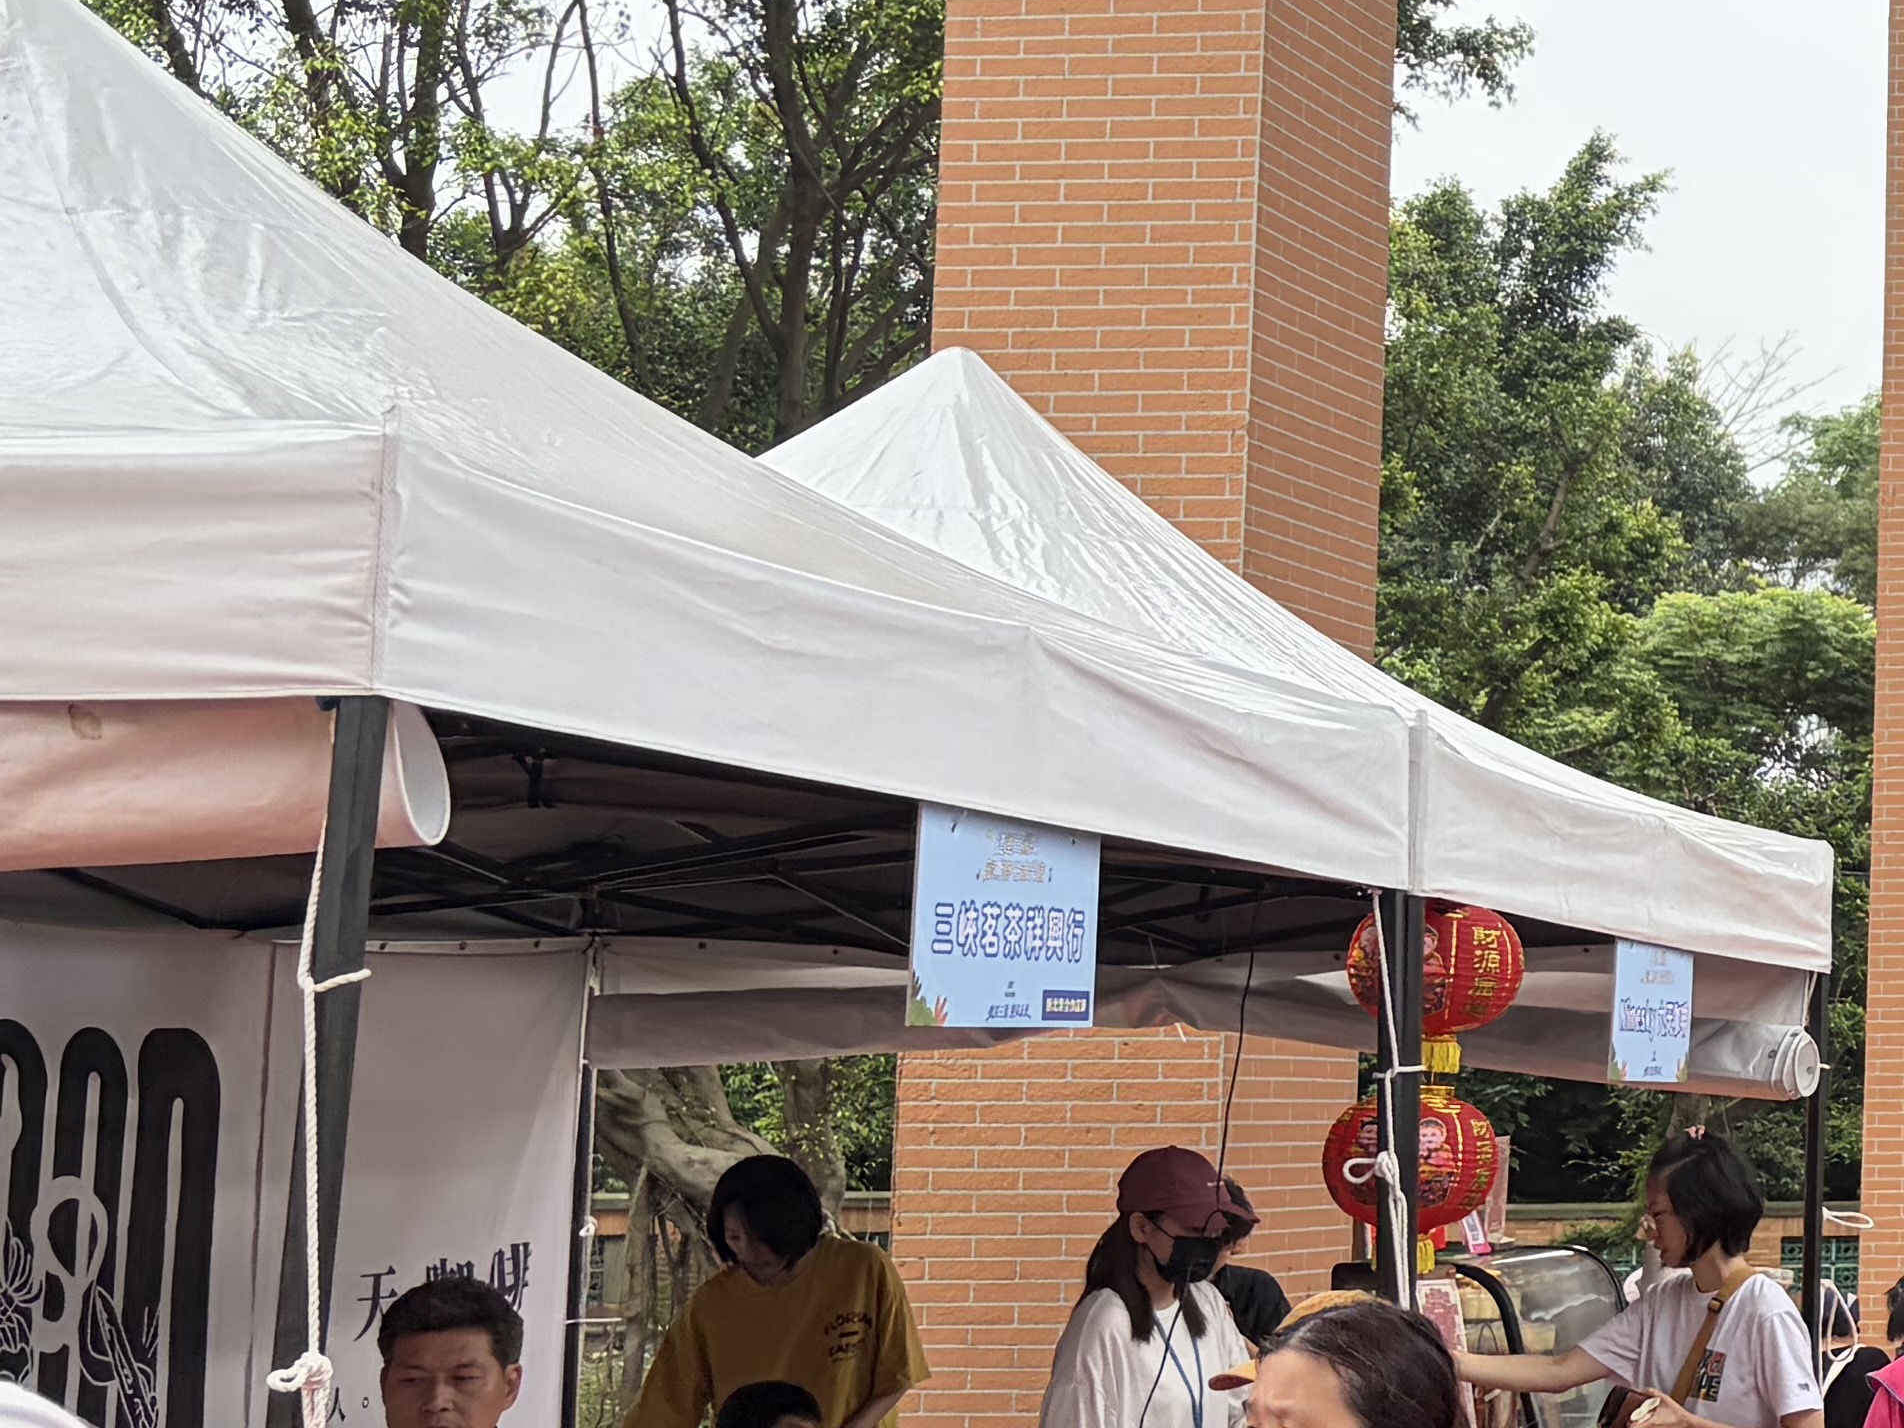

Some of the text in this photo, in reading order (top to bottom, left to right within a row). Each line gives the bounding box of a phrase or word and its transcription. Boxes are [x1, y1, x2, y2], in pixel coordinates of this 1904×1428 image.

[931, 899, 1085, 963] 三峽茗茶祥興行
